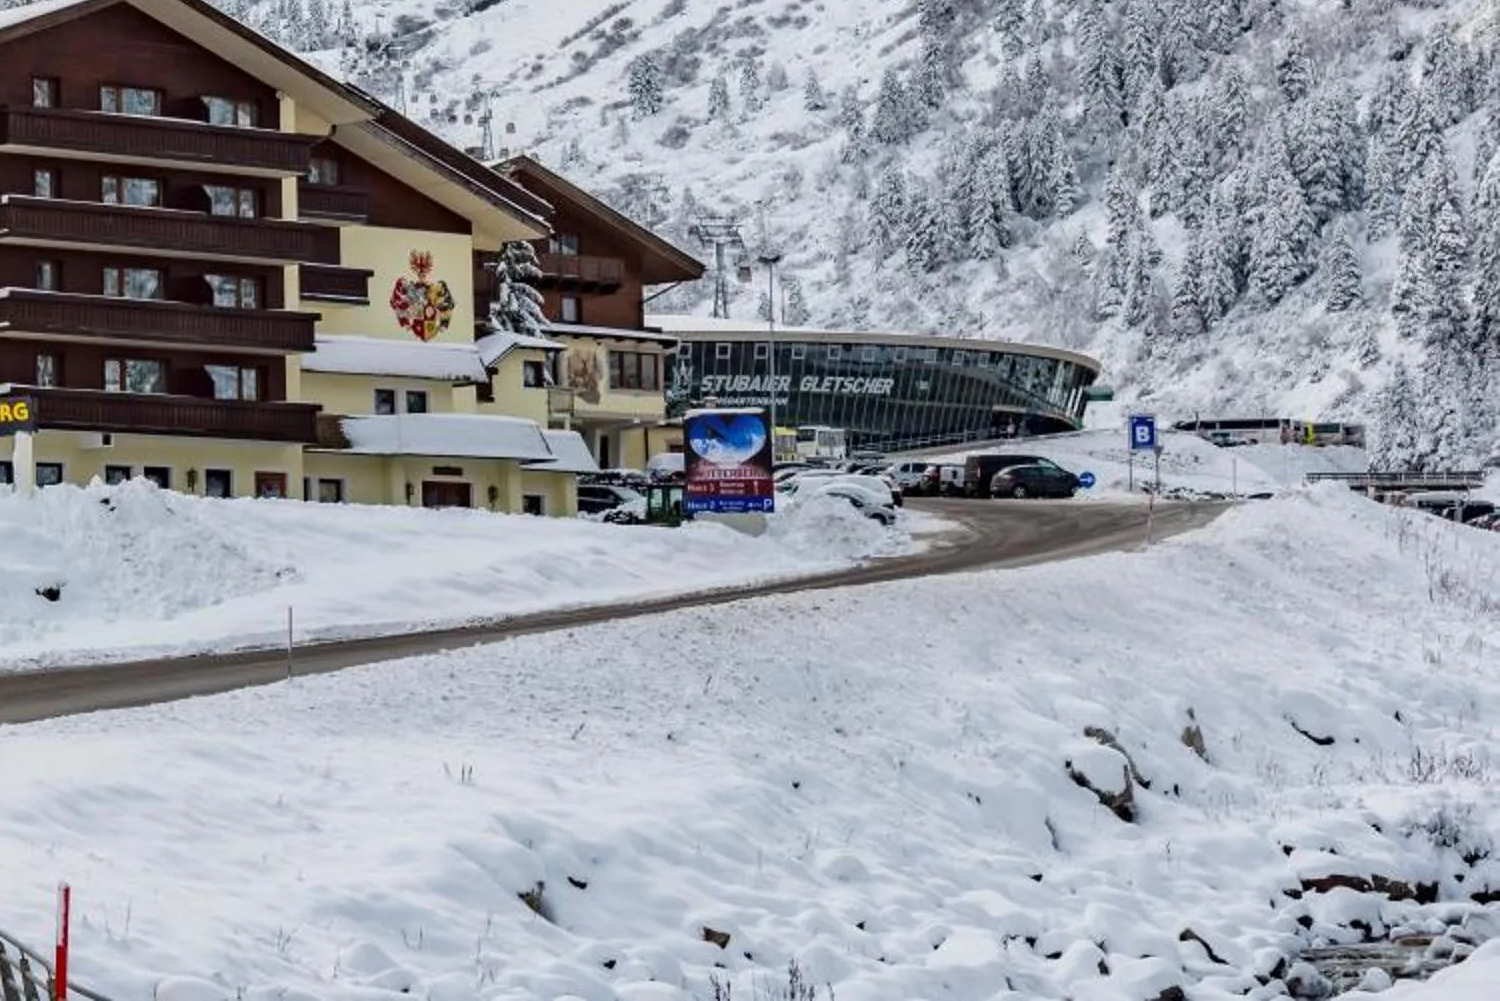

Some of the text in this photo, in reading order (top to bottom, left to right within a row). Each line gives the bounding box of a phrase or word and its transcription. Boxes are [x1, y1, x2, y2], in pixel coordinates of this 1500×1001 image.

[700, 375, 894, 394] STUBAIER GLETSCHER
[1135, 425, 1150, 442] B
